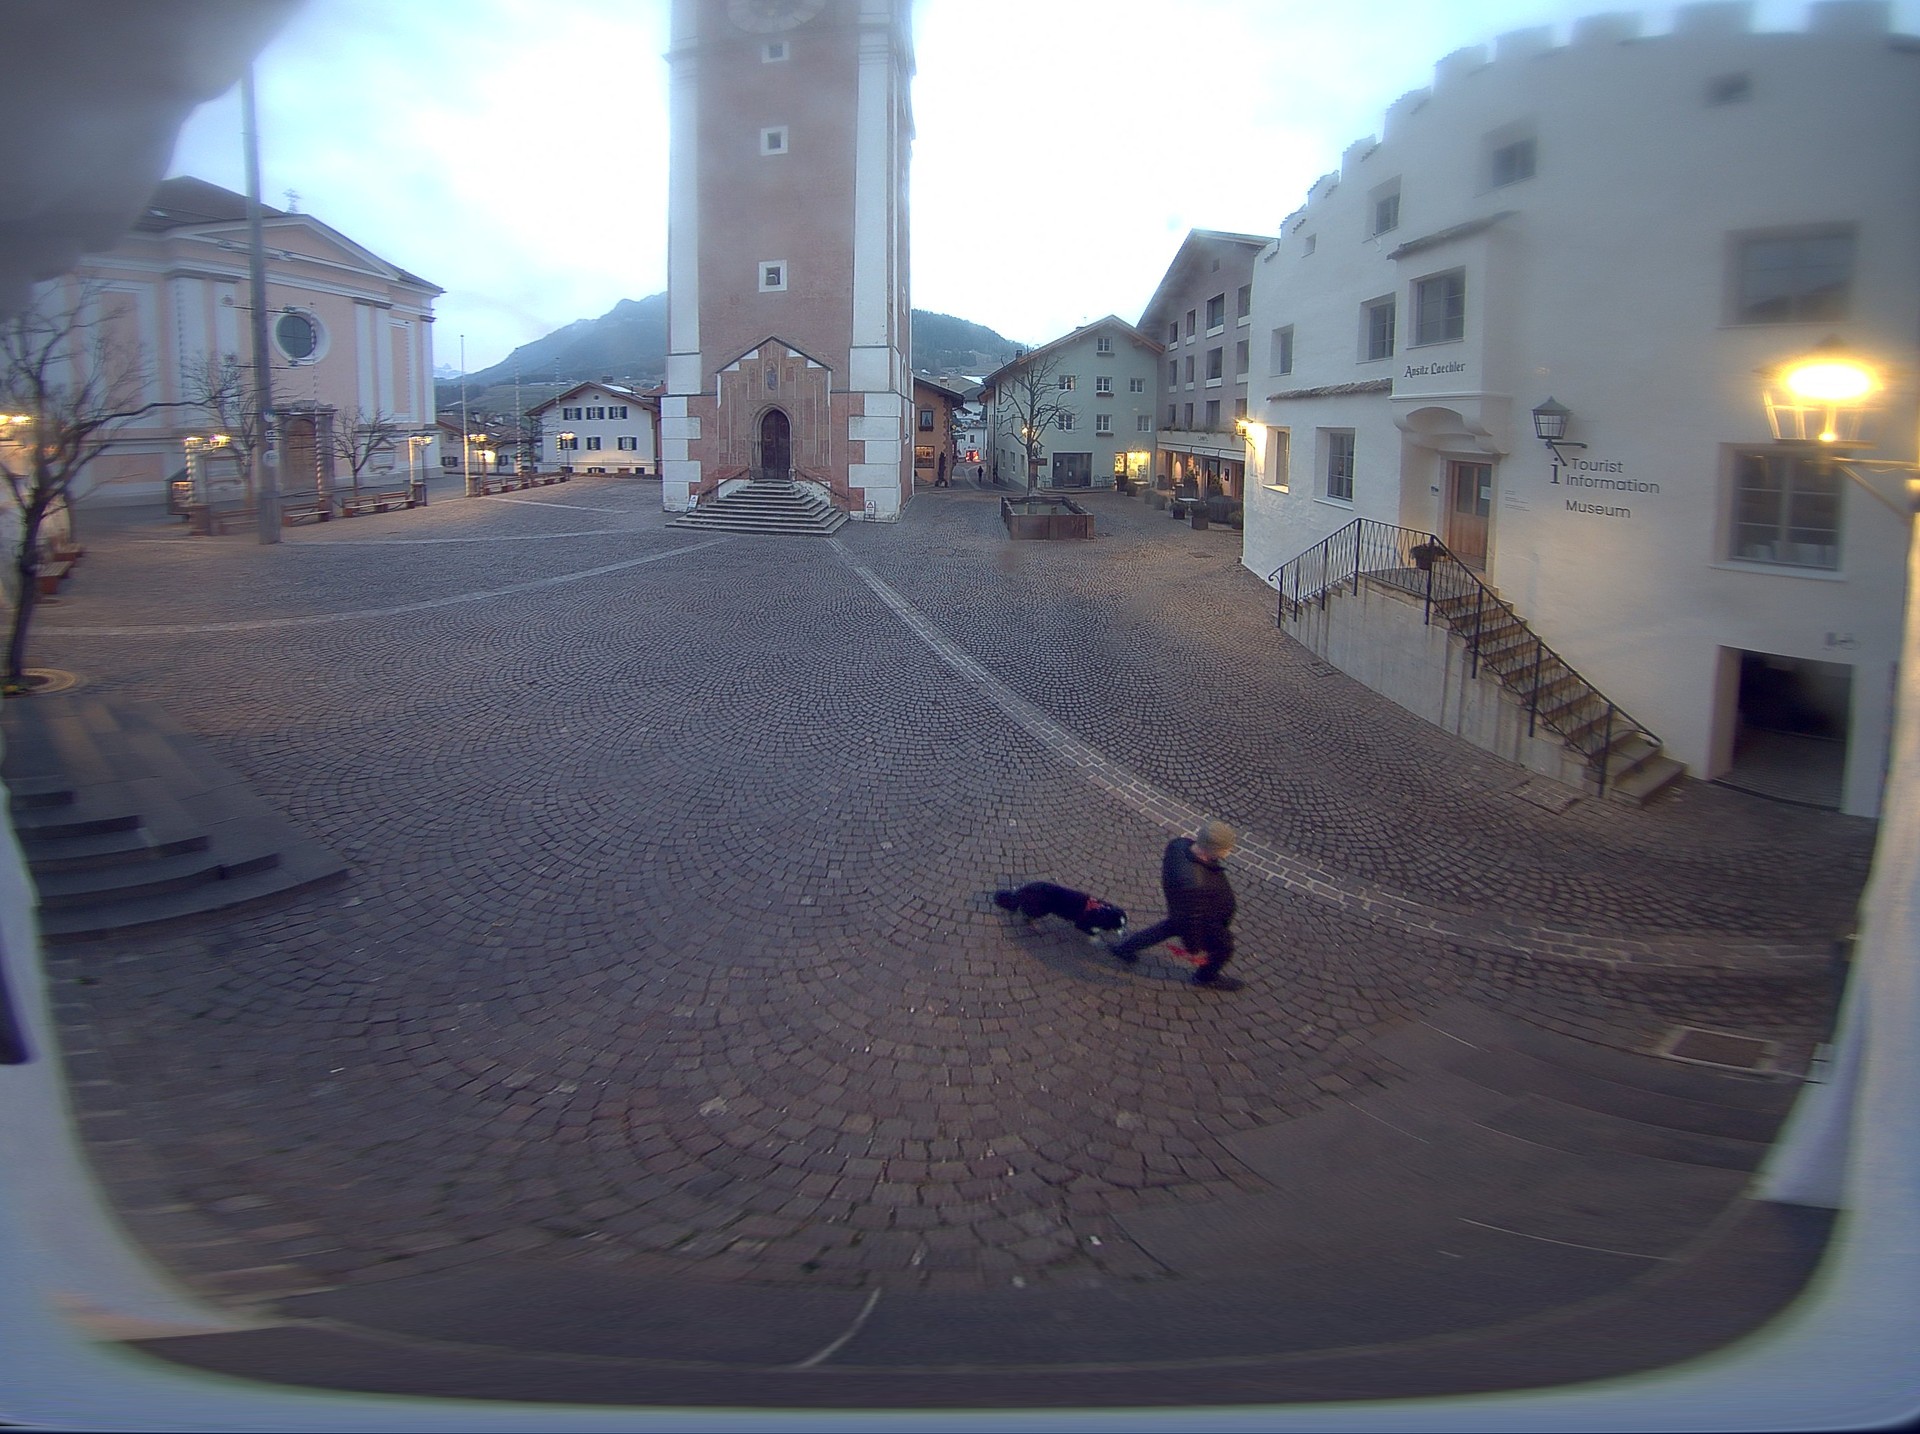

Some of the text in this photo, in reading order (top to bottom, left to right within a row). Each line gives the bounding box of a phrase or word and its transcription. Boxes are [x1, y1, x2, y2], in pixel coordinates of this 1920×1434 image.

[1403, 365, 1429, 378] Ansitz
[1571, 458, 1624, 473] Tourist
[1566, 474, 1660, 494] Information
[1566, 499, 1631, 518] Museum
